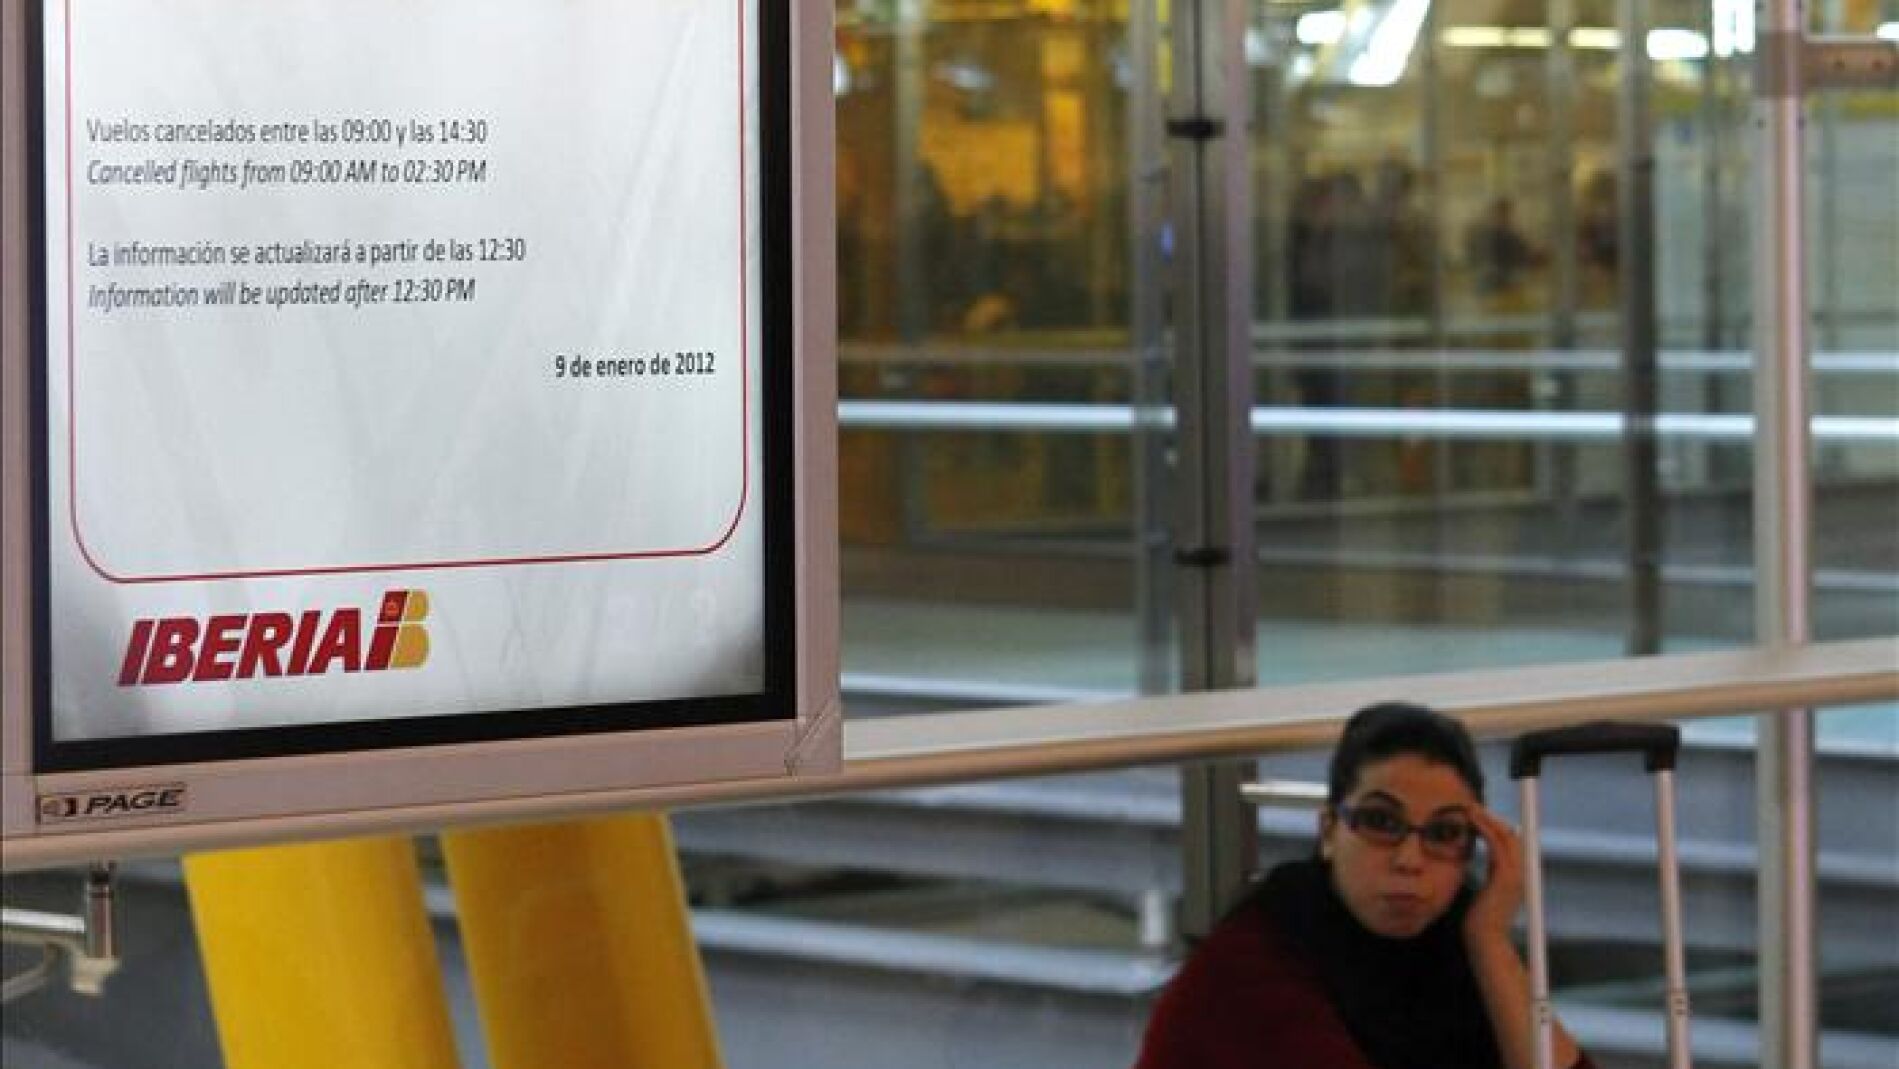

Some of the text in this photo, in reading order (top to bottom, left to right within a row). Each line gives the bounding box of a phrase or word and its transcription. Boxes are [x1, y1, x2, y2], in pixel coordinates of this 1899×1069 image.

[87, 119, 487, 147] Vuelos cancelados entre las 09:00 y las 14:30
[87, 160, 487, 191] Cancelled flights from 09:00 AM to 02:30 PM
[89, 238, 526, 268] La información se actualizará a partir de las 12:30
[89, 279, 476, 312] Information will be updated after 12:30 PM
[556, 352, 715, 378] 9 de enero de 2012
[118, 608, 361, 687] IBERIA
